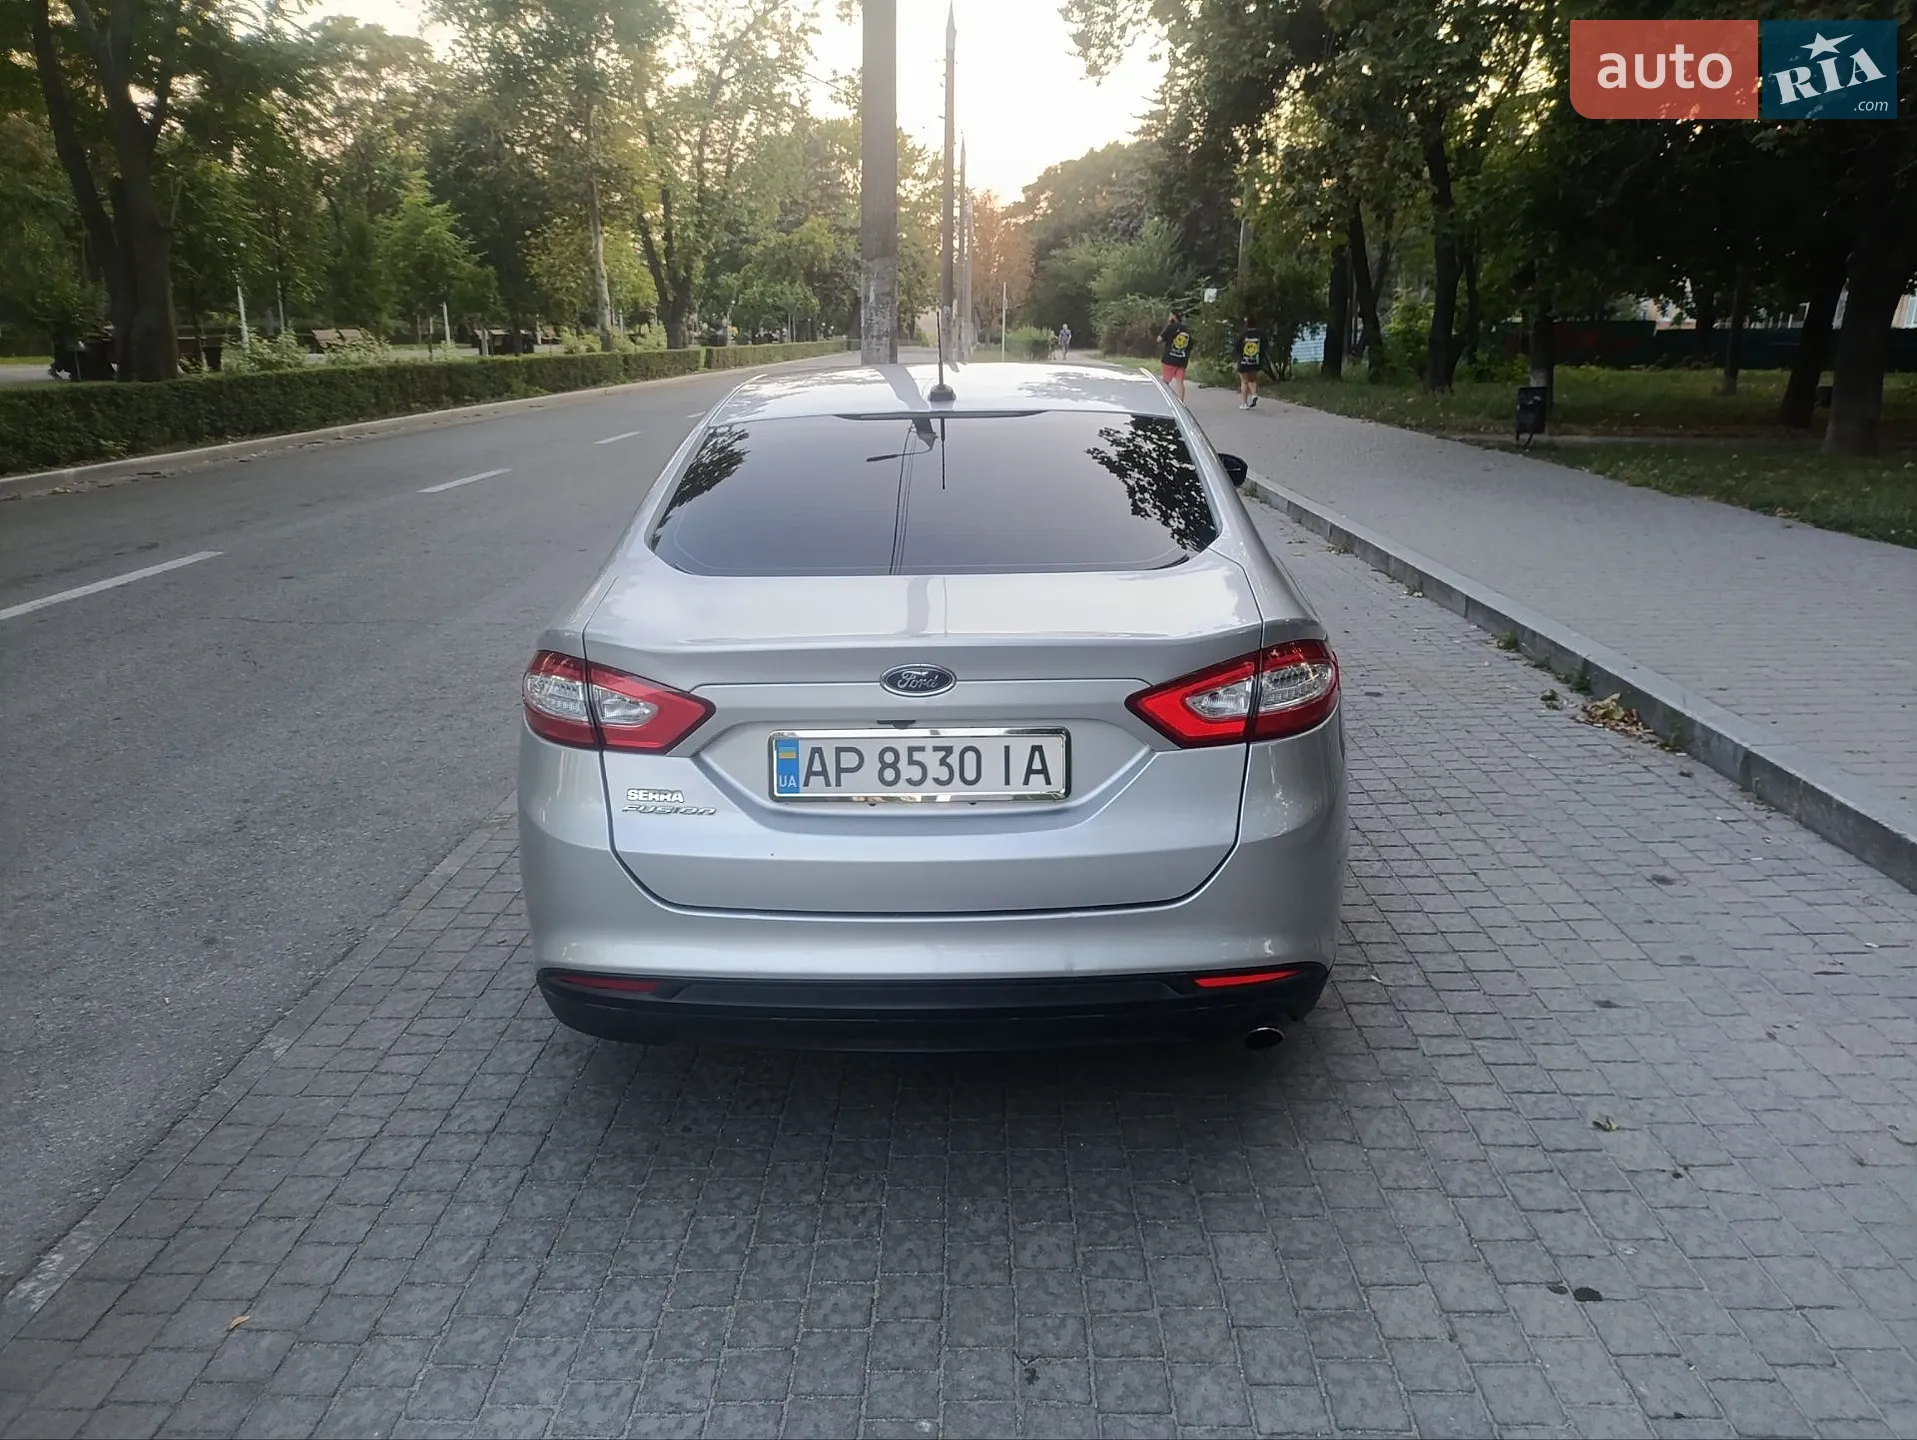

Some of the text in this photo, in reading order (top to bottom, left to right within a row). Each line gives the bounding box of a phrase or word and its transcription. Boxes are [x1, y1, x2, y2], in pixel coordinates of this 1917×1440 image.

[897, 670, 939, 688] Ford
[803, 744, 1053, 788] AP 8530 IA
[778, 775, 797, 788] UA
